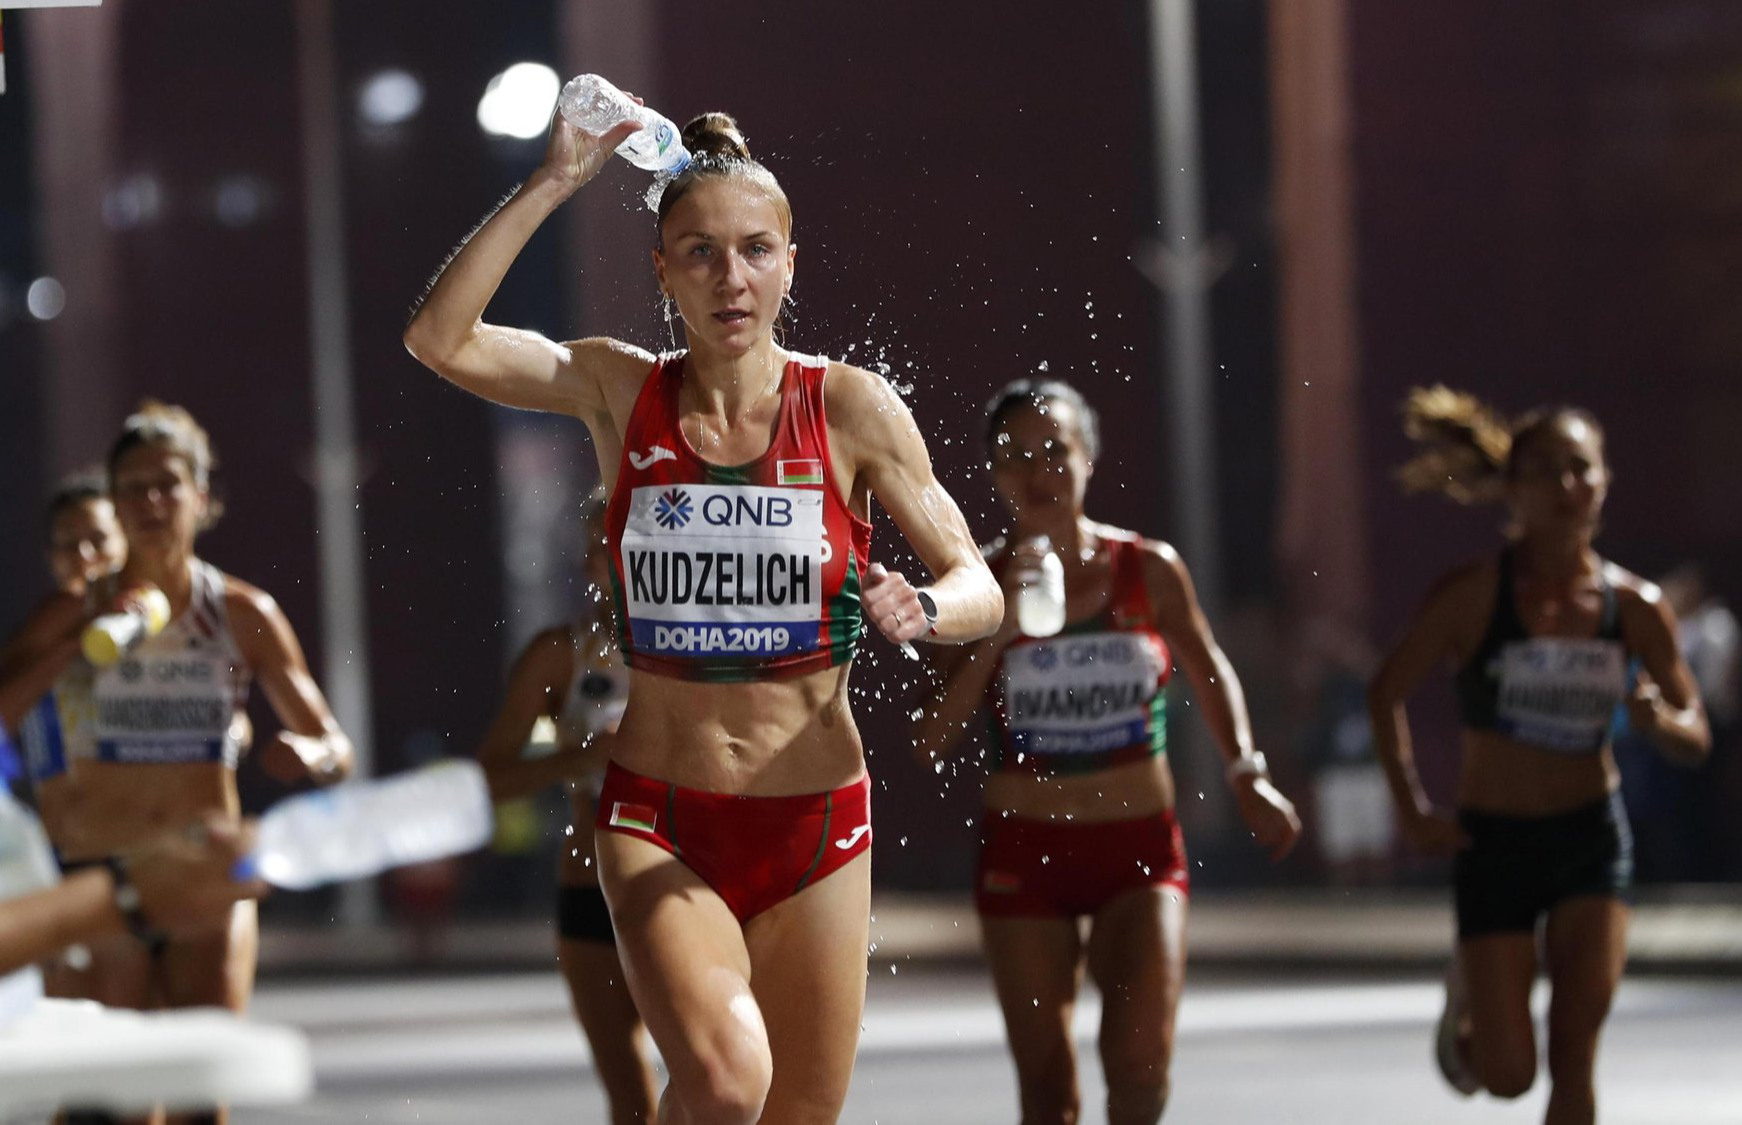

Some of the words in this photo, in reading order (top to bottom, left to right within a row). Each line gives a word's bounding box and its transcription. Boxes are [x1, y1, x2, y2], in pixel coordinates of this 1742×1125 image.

[702, 494, 793, 527] QNB
[628, 550, 811, 606] KUDZELICH
[655, 625, 790, 652] DOHA2019
